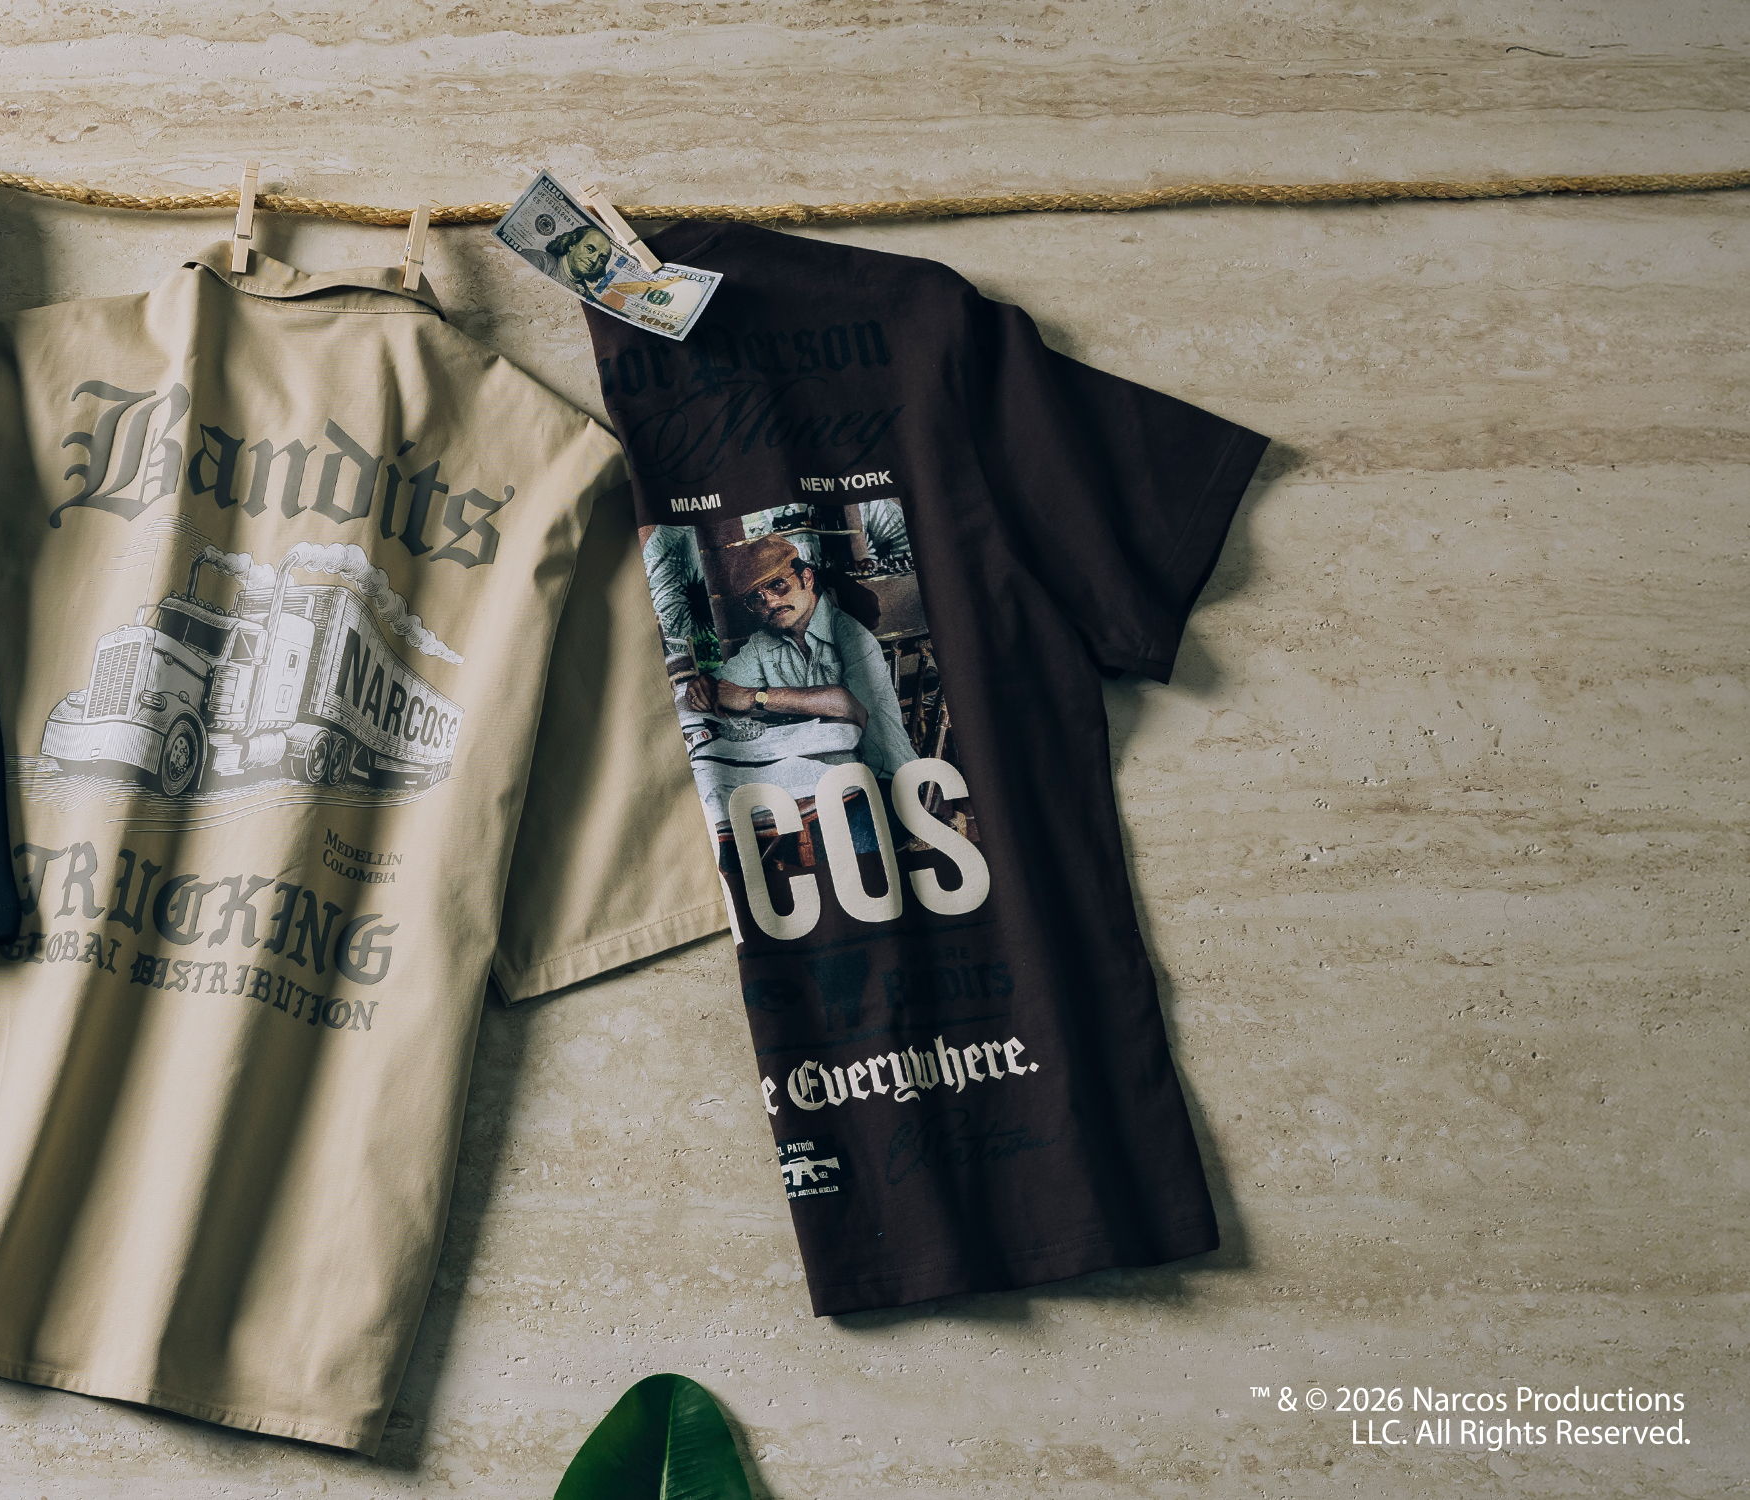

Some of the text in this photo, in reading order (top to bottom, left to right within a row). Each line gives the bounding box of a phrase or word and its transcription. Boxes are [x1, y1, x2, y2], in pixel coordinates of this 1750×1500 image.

[50, 379, 515, 569] Bandits
[670, 493, 722, 513] MIAMI
[800, 471, 893, 493] NEW YORK
[322, 848, 396, 883] COLOMBIA
[706, 757, 990, 946] COS
[13, 840, 400, 985] TRUCKING
[129, 951, 380, 1031] DISTRIBUTION
[787, 1035, 1040, 1111] Everywhere.
